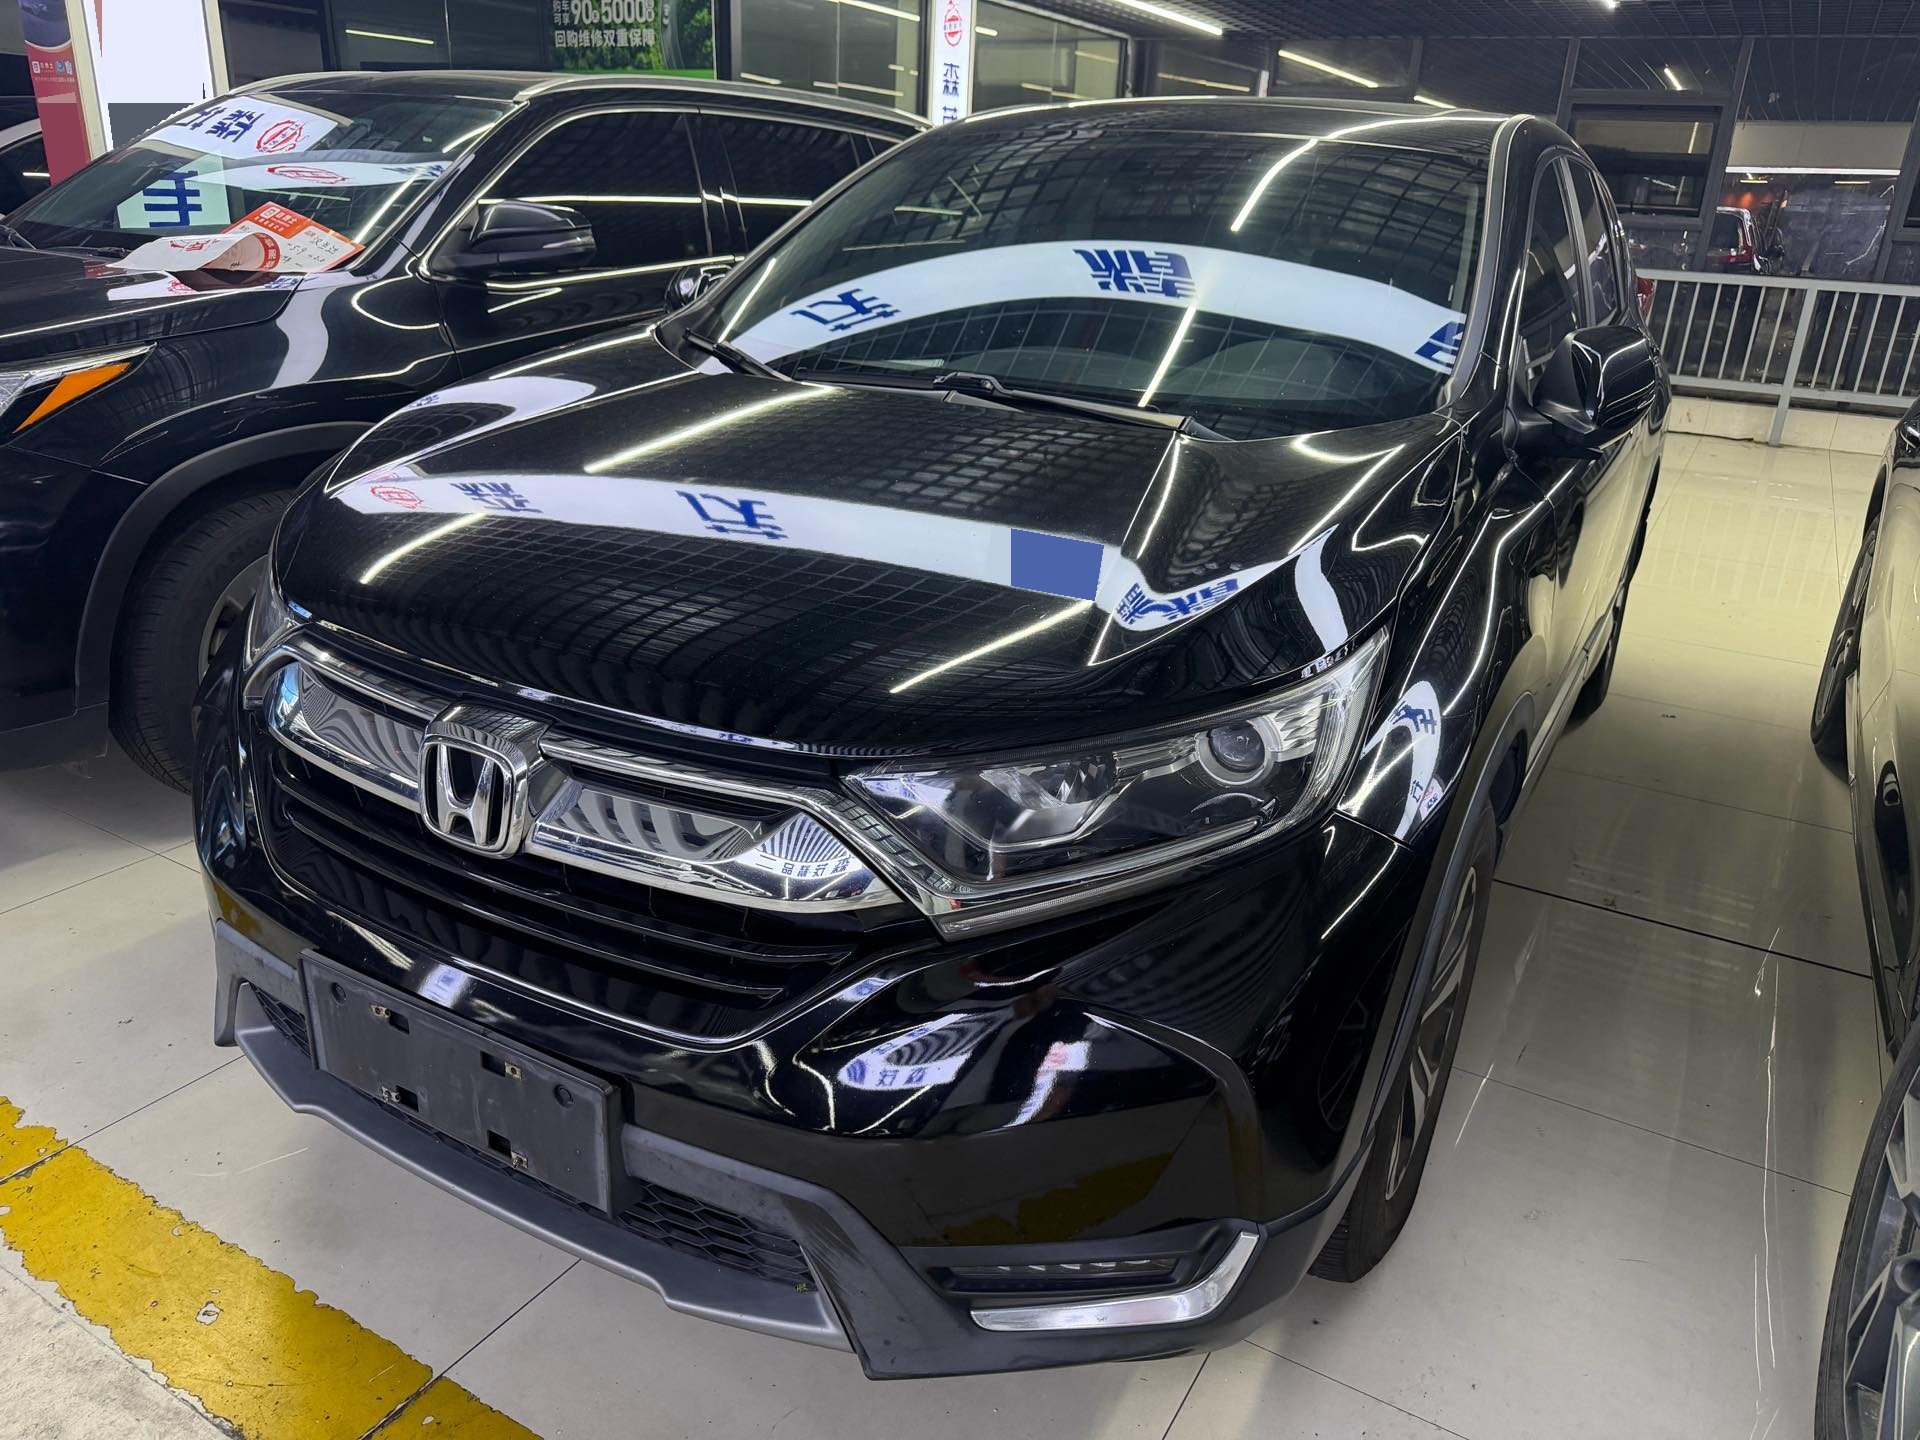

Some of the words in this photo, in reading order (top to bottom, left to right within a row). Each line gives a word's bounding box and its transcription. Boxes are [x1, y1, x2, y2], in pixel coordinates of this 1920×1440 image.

[555, 29, 655, 47] 回购维修双重保障
